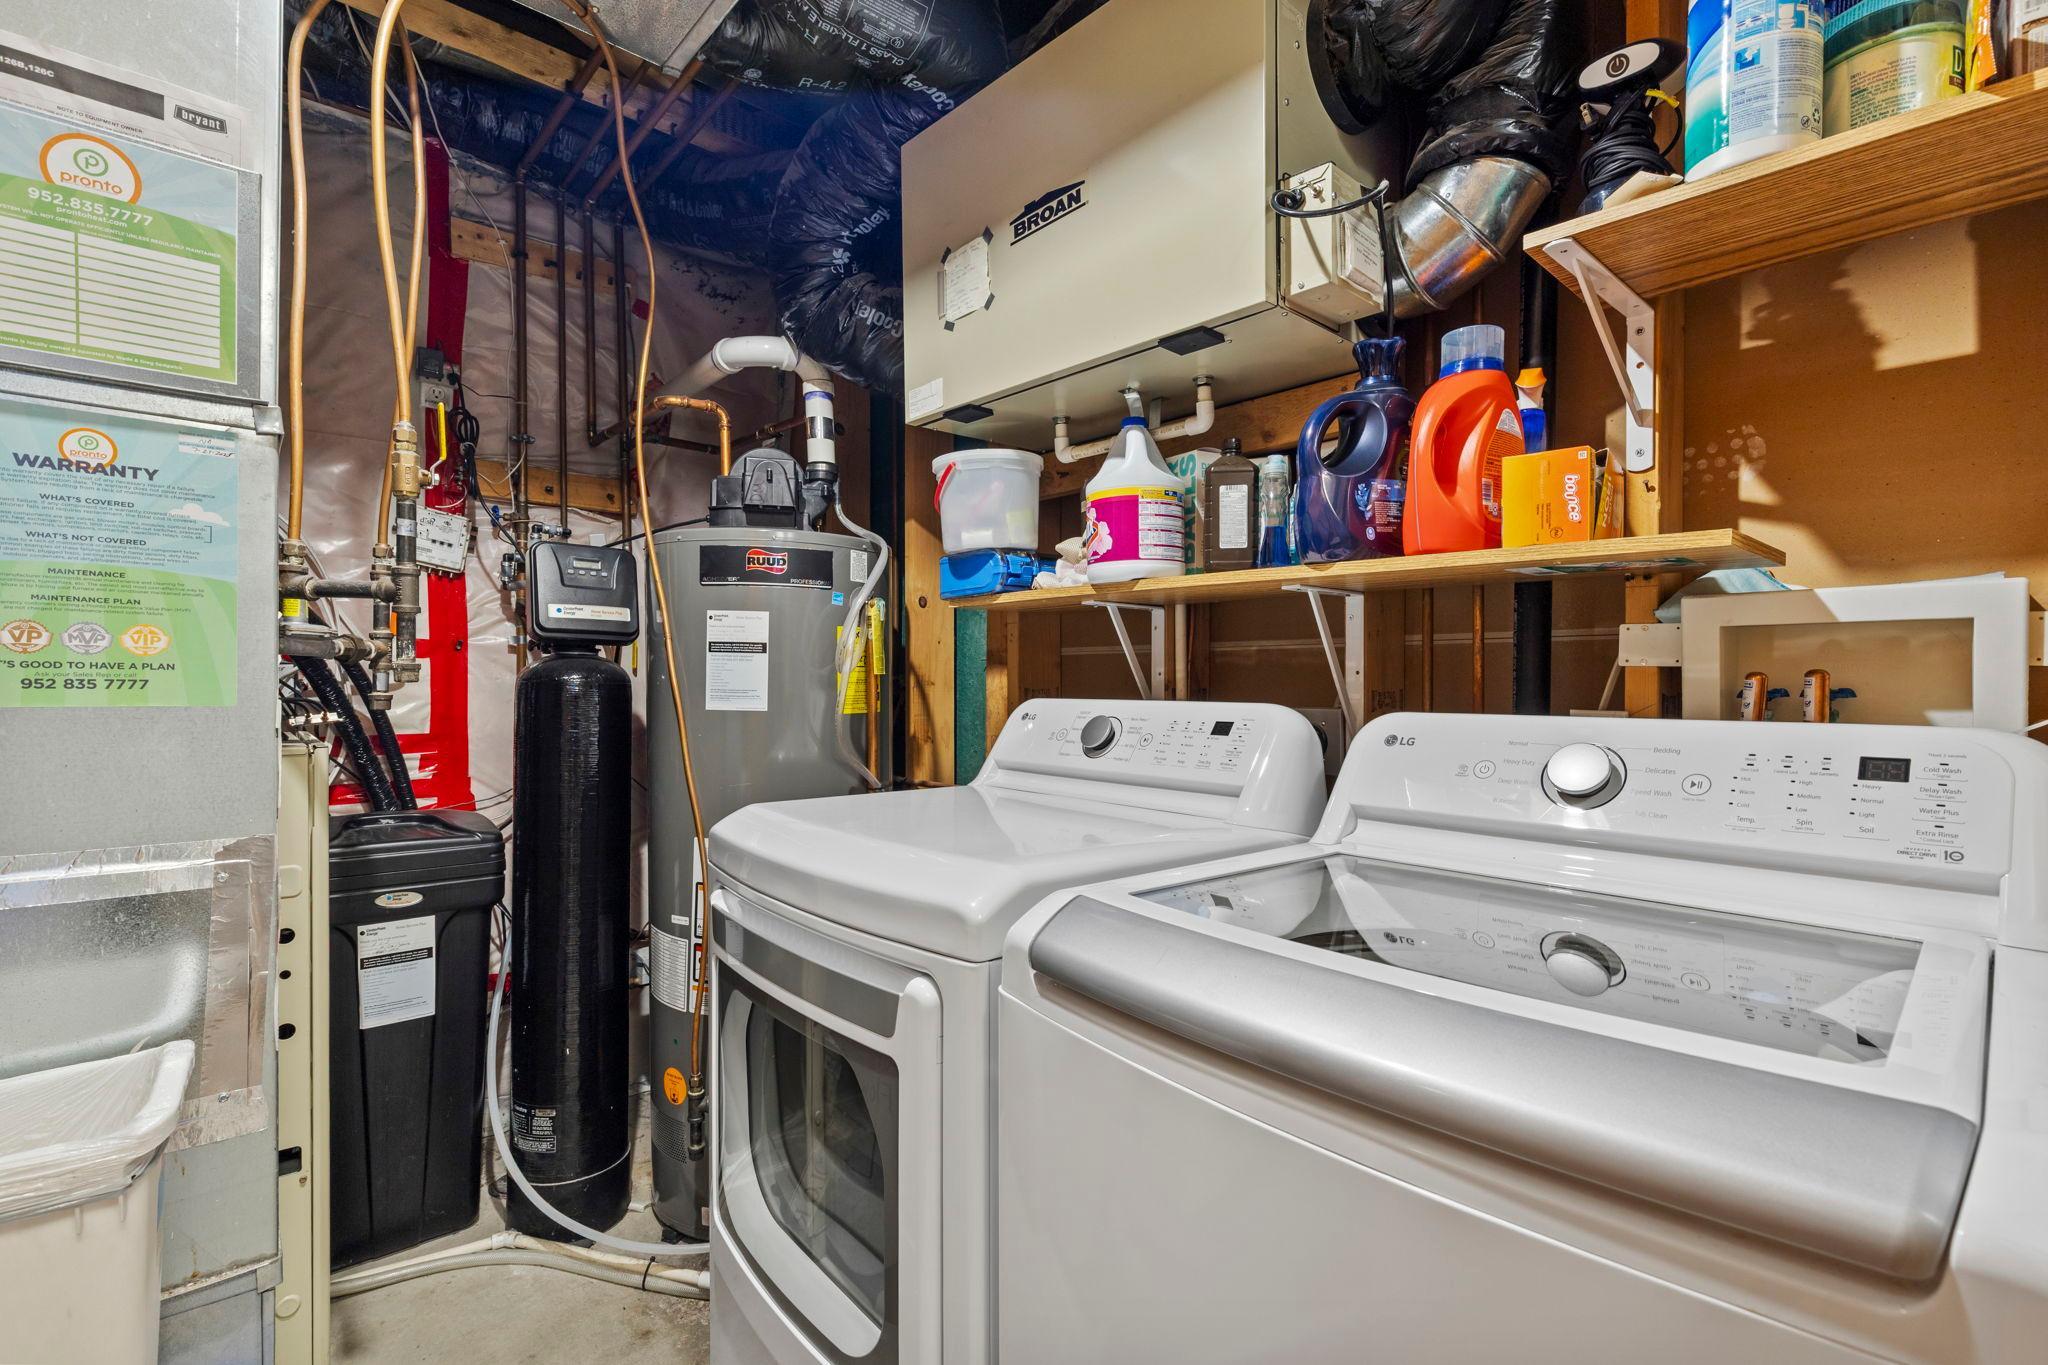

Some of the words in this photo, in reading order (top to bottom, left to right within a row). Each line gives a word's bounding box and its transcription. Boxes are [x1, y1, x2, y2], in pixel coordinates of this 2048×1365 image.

[869, 46, 905, 66] CLASS
[798, 77, 847, 90] R-4.2
[57, 105, 74, 115] NOTE
[85, 113, 119, 129] EQUIPMENT
[120, 124, 143, 133] OWNER
[182, 110, 221, 130] bryant
[60, 170, 123, 195] pronto
[27, 186, 153, 227] 952.835.7777
[56, 206, 128, 228] prontoheat.com
[1013, 188, 1082, 239] BROAN
[70, 448, 107, 459] pronto
[12, 452, 159, 481] WARRANTY
[40, 493, 81, 503] WHAT'S
[85, 498, 134, 509] COVERED
[1564, 473, 1581, 523] bounce
[25, 531, 68, 540] WHAT'S
[97, 537, 147, 546] COVERED
[746, 556, 787, 567] RUUD
[48, 568, 126, 578] MAINTENANCE
[31, 594, 110, 604] MAINTENANCE
[8, 629, 43, 643] VP
[68, 635, 106, 645] MVP
[130, 635, 161, 645] VIP
[20, 660, 62, 669] GOOD
[67, 661, 85, 669] TO
[90, 662, 124, 670] HAVE
[142, 663, 175, 671] PLAN
[21, 678, 56, 689] 952
[64, 678, 97, 689] 835
[104, 679, 149, 690] 7777
[1654, 747, 1681, 756] Bedding
[1653, 789, 1672, 797] Wash
[1919, 786, 1940, 795] Delay
[1859, 811, 1875, 819] Light
[1919, 807, 1941, 815] Water
[1943, 808, 1960, 816] Plus
[1859, 826, 1874, 834] Soil
[1916, 829, 1936, 837] Extra
[1938, 830, 1959, 839] Rinse
